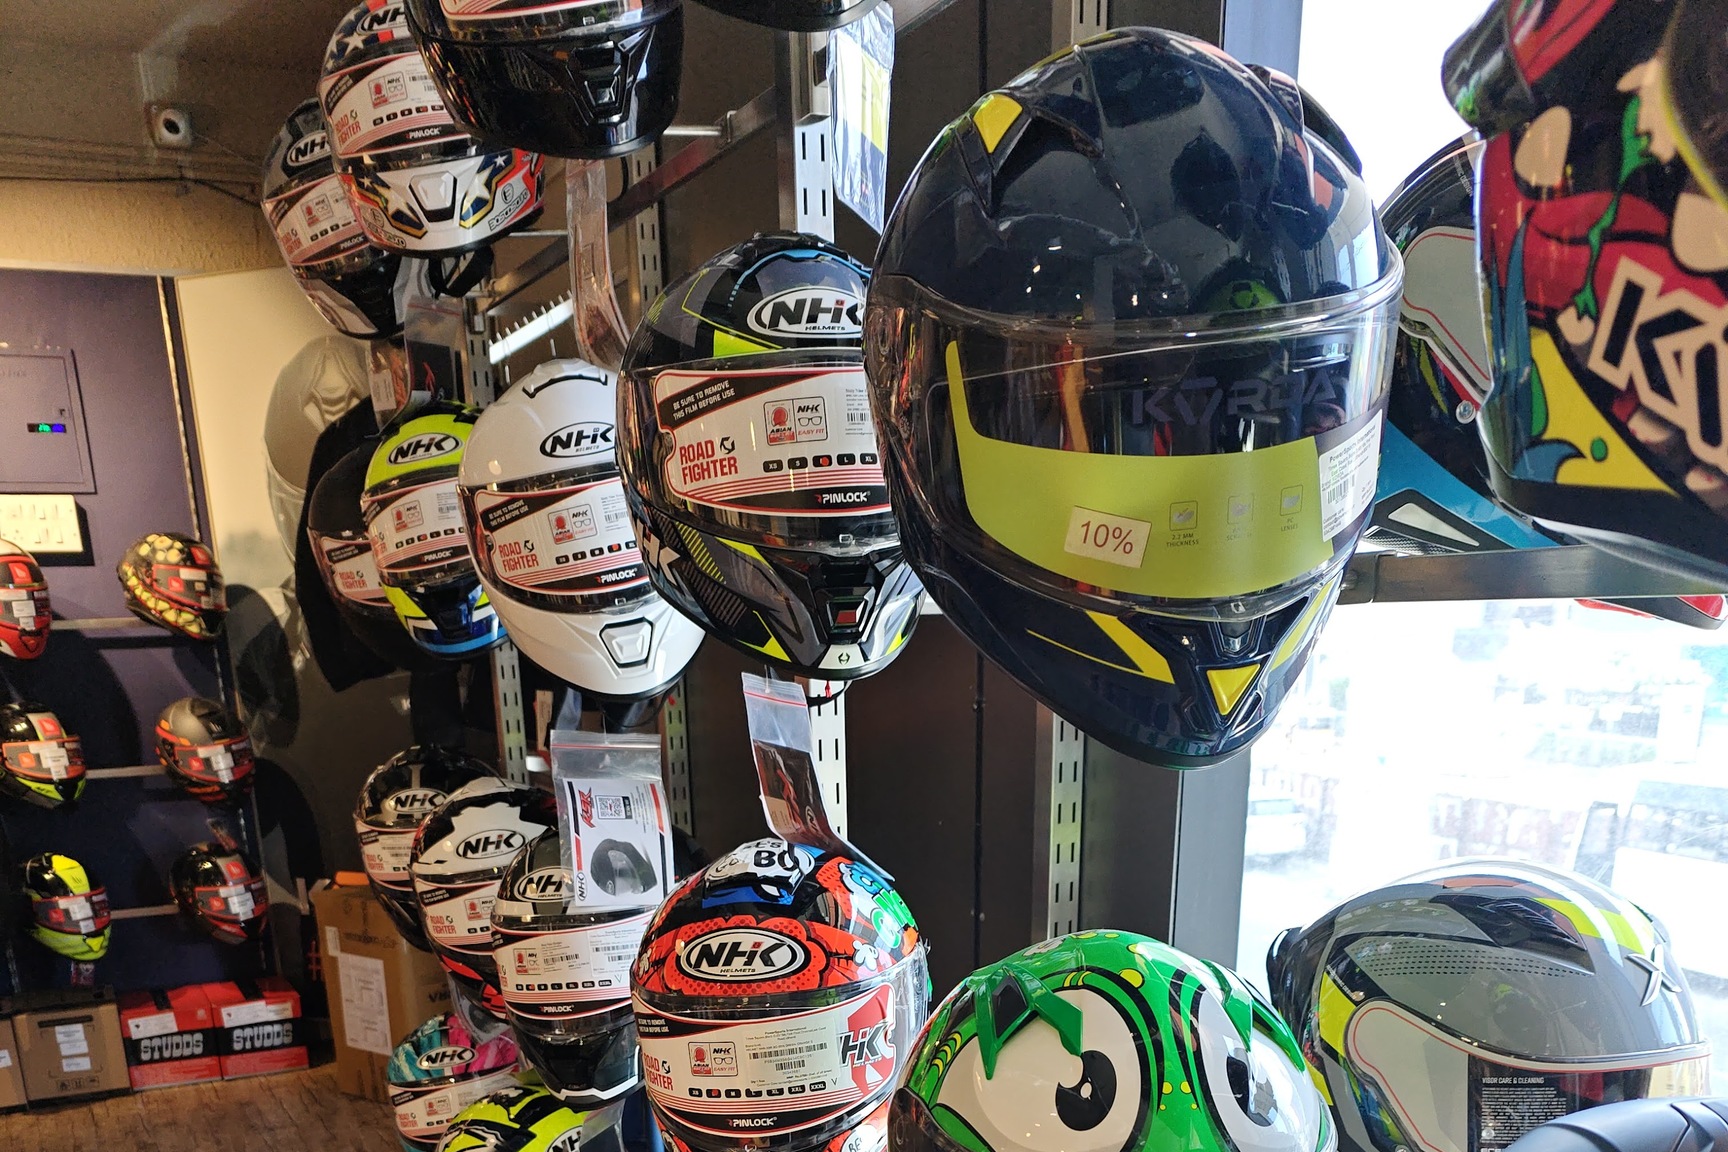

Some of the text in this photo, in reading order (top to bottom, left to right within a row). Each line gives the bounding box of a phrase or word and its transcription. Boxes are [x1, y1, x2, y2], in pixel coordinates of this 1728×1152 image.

[369, 6, 406, 31] NH
[408, 127, 441, 139] PINLOCK
[294, 136, 331, 162] NH
[767, 297, 862, 330] NHK
[673, 380, 730, 411] BE SURE TO REMOVE
[673, 388, 736, 421] THIS FILM BEFORE USE
[396, 436, 450, 459] NHK
[551, 428, 615, 453] NHK
[679, 439, 715, 466] ROAD
[681, 457, 739, 485] FIGHTER
[822, 492, 871, 504] PINLOCK
[498, 541, 521, 557] ROAD
[1081, 520, 1134, 555] 10%
[1166, 539, 1199, 548] THICKNESS
[502, 553, 540, 573] FIGHTER
[601, 570, 636, 584] PINLOCK
[395, 793, 439, 808] NHK
[462, 832, 517, 859] NHK
[694, 941, 787, 968] NHK
[544, 1005, 573, 1013] PINLOCK
[140, 1032, 204, 1061] STUDDS
[233, 1023, 293, 1051] STUDDS
[836, 1020, 888, 1068] HK
[426, 1049, 468, 1065] NHK
[643, 1053, 660, 1072] ROAD
[646, 1068, 674, 1091] FIGHTER
[733, 1118, 774, 1127] PINLOCK
